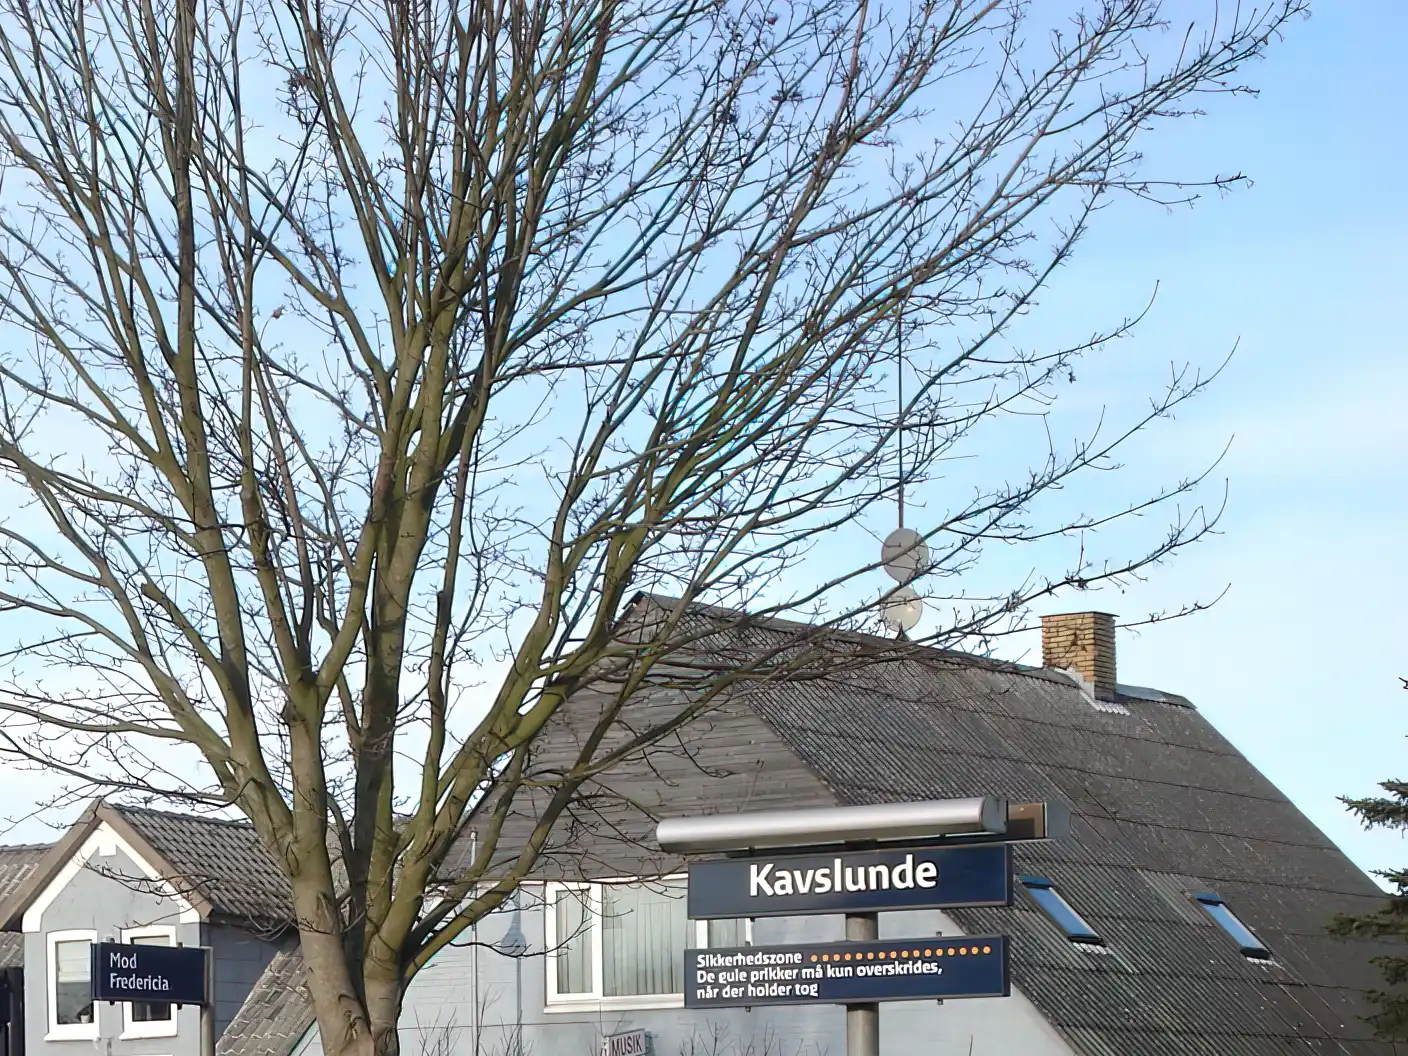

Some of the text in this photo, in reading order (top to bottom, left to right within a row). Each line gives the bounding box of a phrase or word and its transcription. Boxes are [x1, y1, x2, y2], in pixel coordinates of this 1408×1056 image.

[749, 854, 939, 897] Kavslunde
[109, 952, 137, 969] Mod
[696, 951, 803, 968] Sikkerhedszone
[696, 960, 943, 984] De gule prikker må kun overskrides,
[109, 972, 170, 991] Fredericia
[696, 983, 819, 999] når der holder tog
